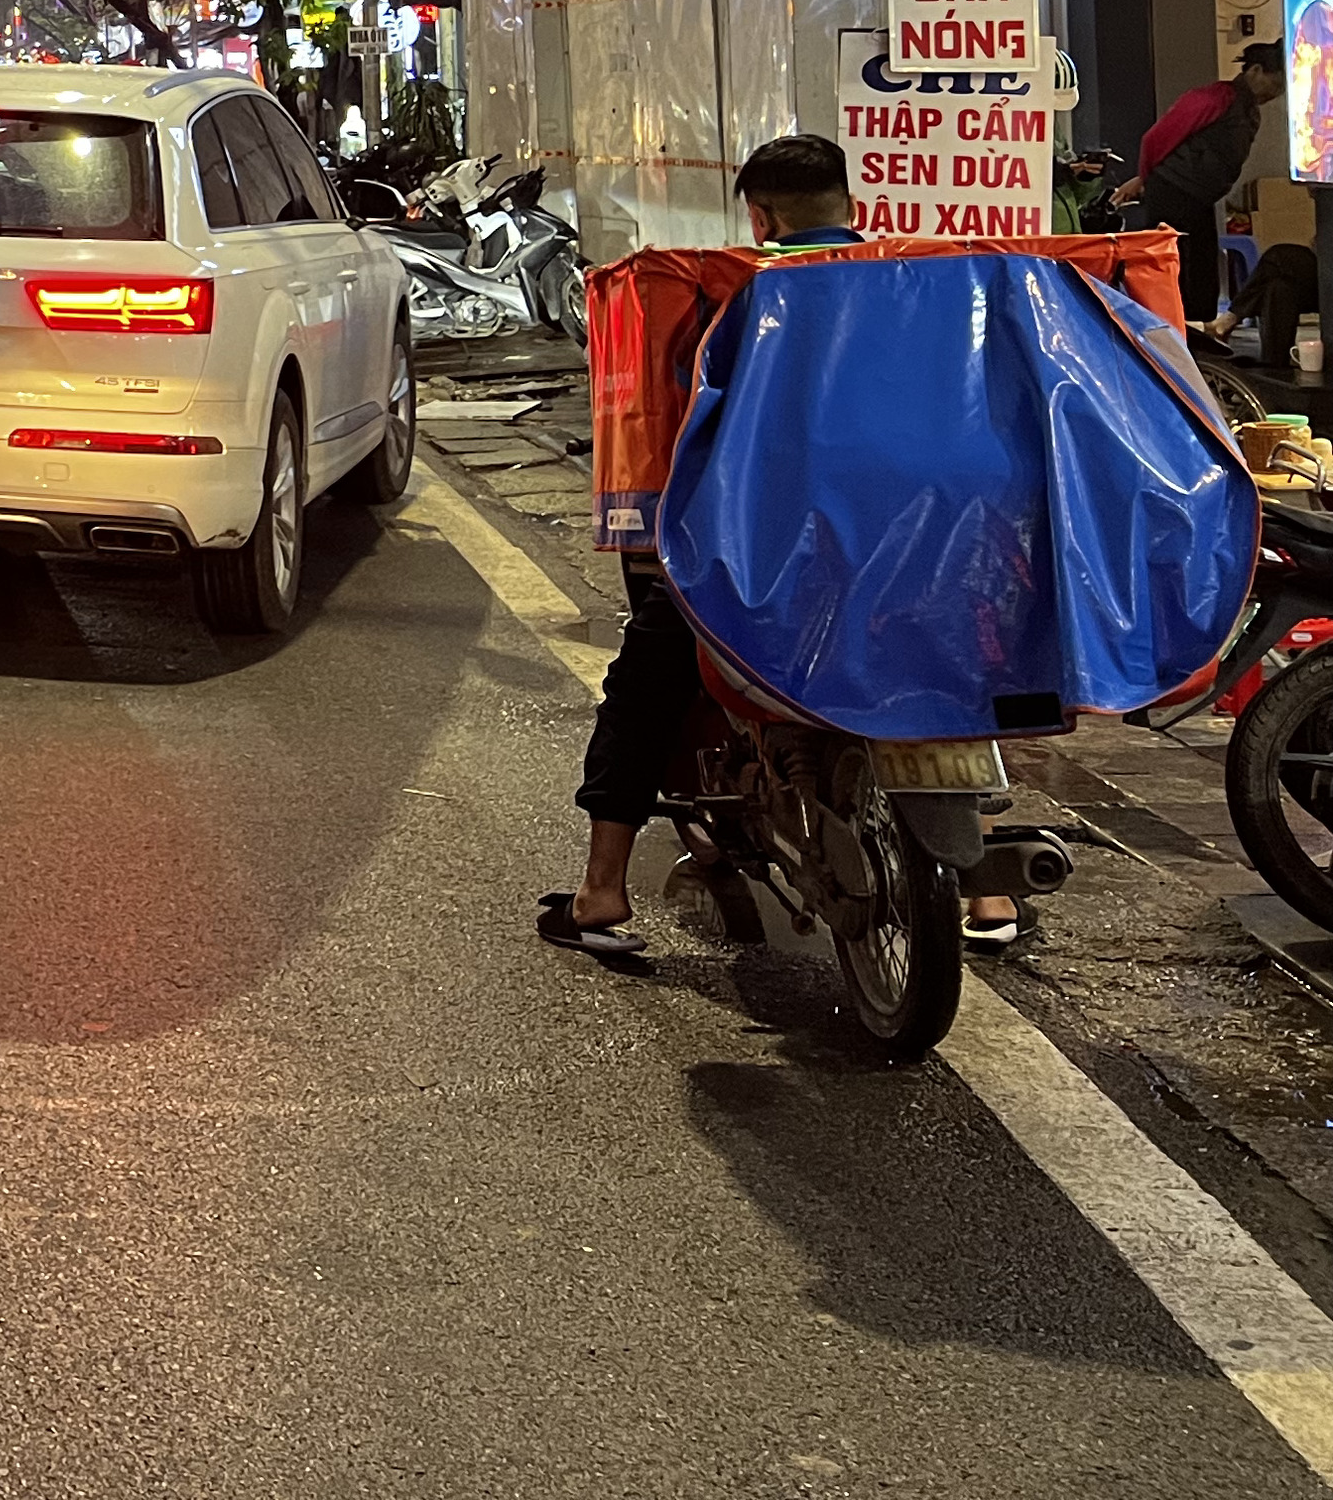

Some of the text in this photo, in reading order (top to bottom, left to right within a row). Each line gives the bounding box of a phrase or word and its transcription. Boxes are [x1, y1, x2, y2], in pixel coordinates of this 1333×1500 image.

[901, 9, 1025, 59] NÓNG
[844, 96, 1046, 146] THẬP CẨM
[861, 147, 1032, 189] SEN DỪA
[934, 204, 1041, 237] XANH
[122, 377, 160, 388] TFSI
